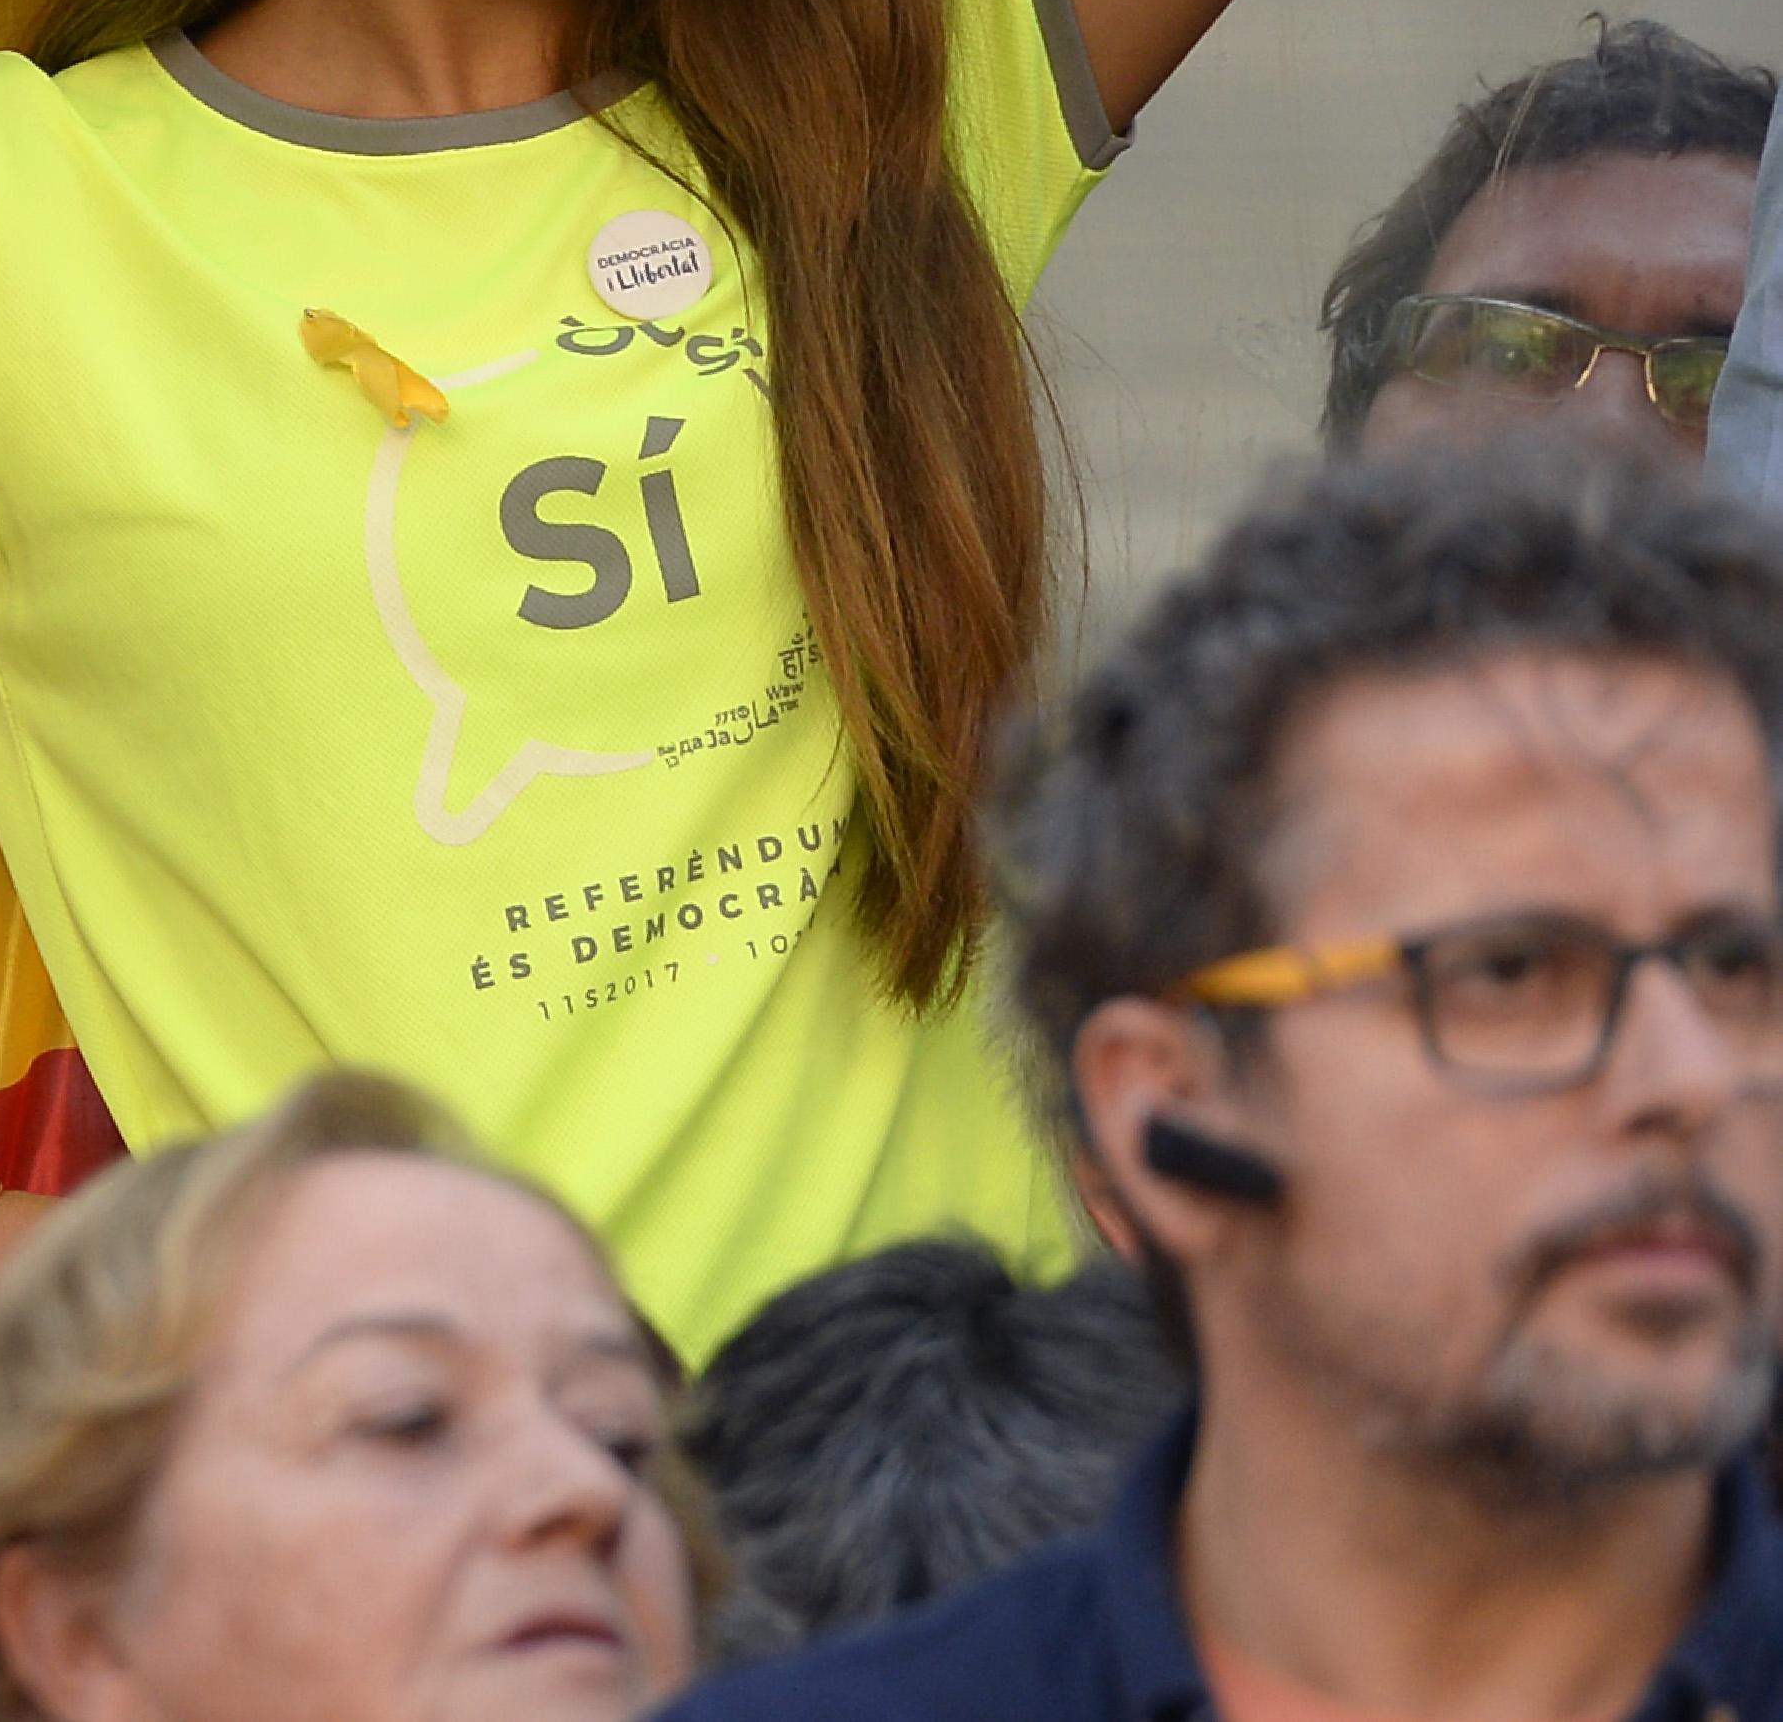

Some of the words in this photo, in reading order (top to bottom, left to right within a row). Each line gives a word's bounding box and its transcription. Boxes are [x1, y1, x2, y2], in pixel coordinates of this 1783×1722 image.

[597, 236, 696, 269] DEMOCRÀCIA
[615, 249, 699, 290] Llibertat
[470, 953, 532, 990] ÉS
[538, 960, 679, 1021] 11S2017
